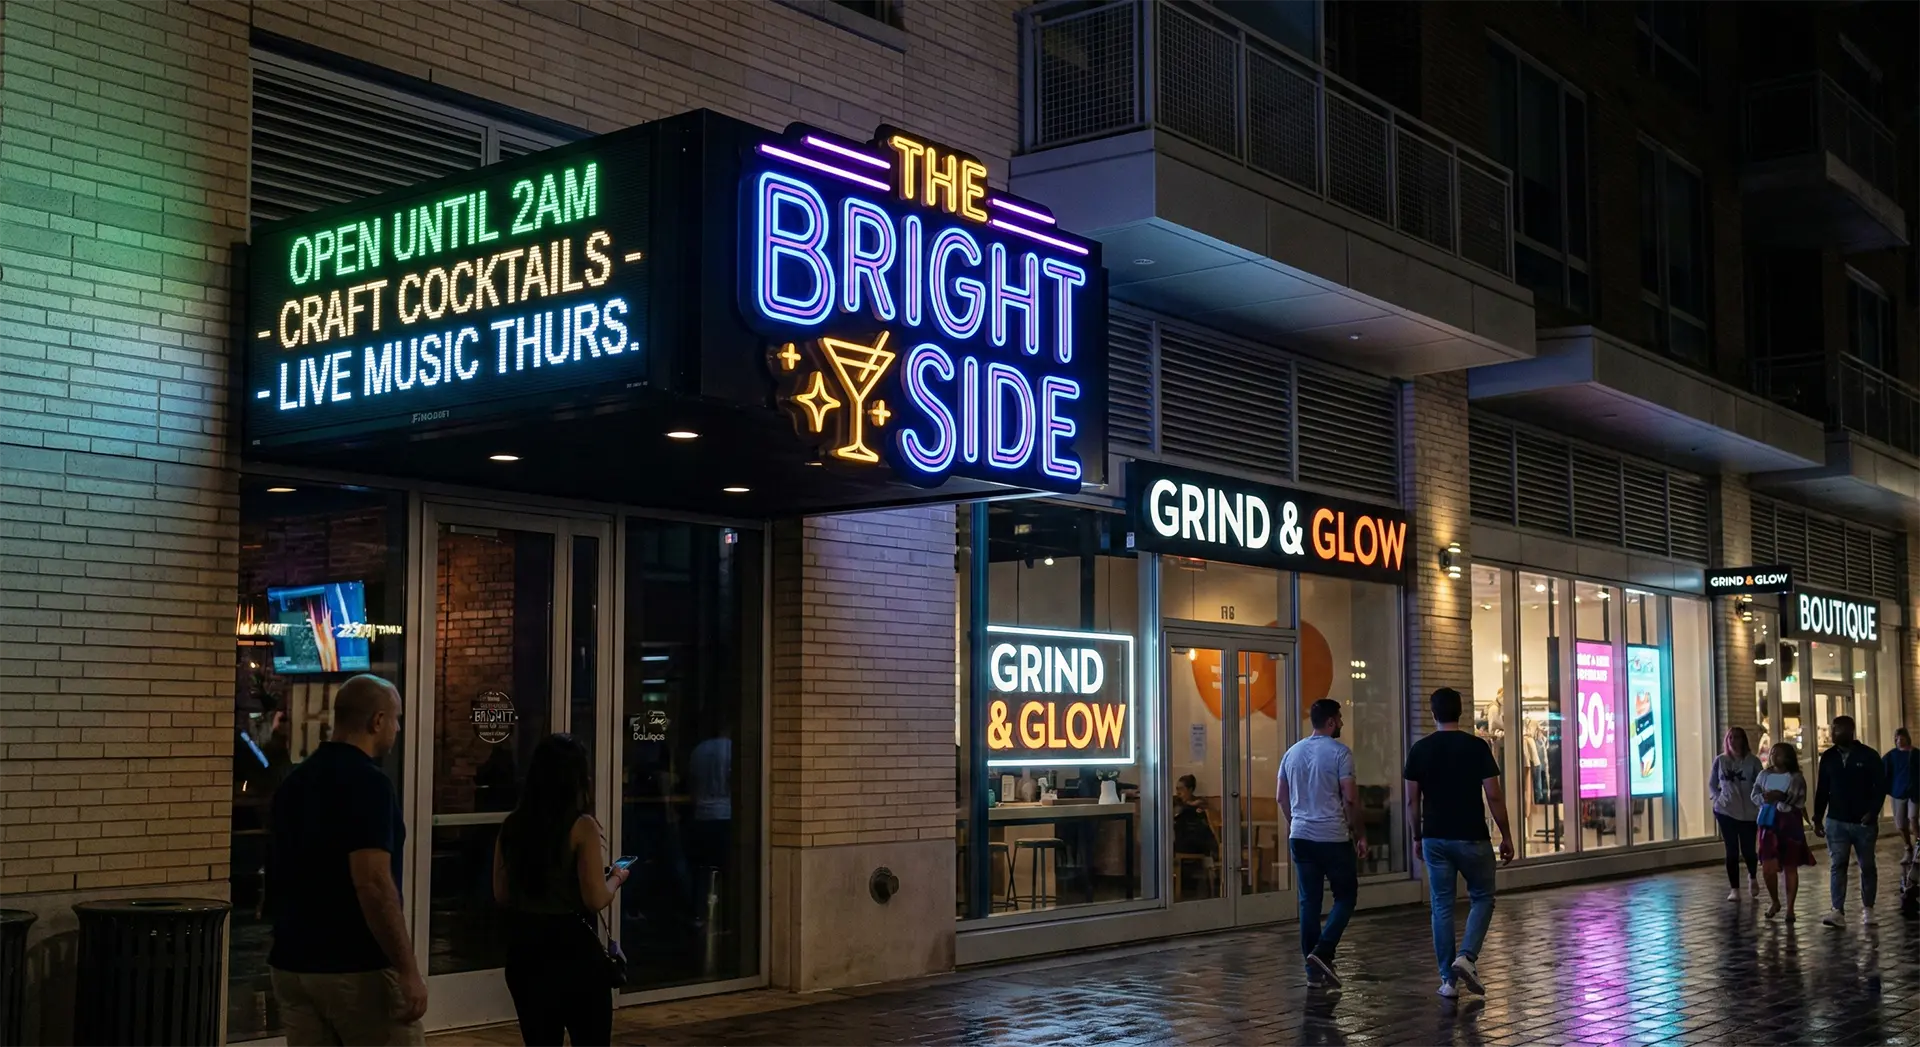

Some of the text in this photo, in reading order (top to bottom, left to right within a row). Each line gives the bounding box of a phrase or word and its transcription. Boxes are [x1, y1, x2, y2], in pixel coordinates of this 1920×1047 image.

[290, 162, 598, 286] OPEN UNTIL 2AM
[888, 136, 988, 223] THE
[279, 279, 388, 350] CRAFT
[398, 230, 612, 325] COCKTAILS
[757, 171, 1086, 364] BRIGHT
[279, 350, 352, 411] LIVE
[363, 327, 479, 397] MUSIC
[491, 297, 640, 374] THURS.
[902, 343, 1082, 480] SIDE
[1149, 478, 1407, 571] GRIND & GLOW
[1710, 573, 1788, 587] GRIND & GLOW
[1799, 593, 1878, 643] BOUTIQUE
[990, 643, 1104, 694] GRIND
[987, 700, 1127, 750] & GLOW
